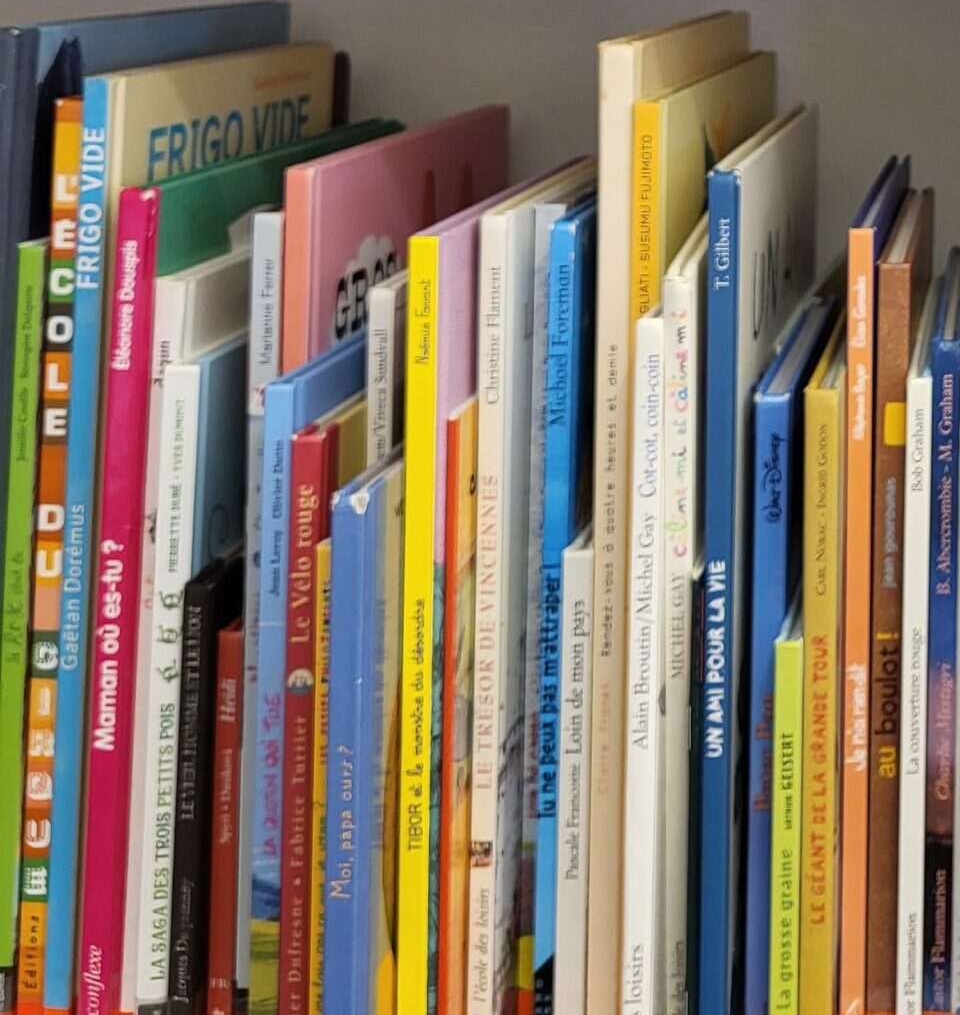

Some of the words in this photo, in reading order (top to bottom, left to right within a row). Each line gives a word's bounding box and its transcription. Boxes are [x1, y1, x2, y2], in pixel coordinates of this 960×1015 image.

[82, 127, 105, 191] VIDE
[77, 202, 102, 289] FRIGO
[714, 217, 731, 271] Gilbert
[715, 274, 730, 290] T.
[63, 503, 85, 593] Dorémus
[102, 539, 124, 554] ?
[101, 560, 124, 619] es-tu
[709, 559, 726, 594] VIE
[571, 600, 591, 638] pays
[709, 596, 726, 622] LA
[61, 598, 82, 671] Gaëtan
[97, 624, 121, 654] où
[875, 632, 898, 641] !
[570, 643, 585, 683] mon
[708, 629, 726, 684] POUR
[811, 633, 829, 683] TOUR
[93, 660, 119, 751] Maman
[566, 688, 584, 709] de
[707, 688, 726, 724] AMI
[875, 646, 899, 736] boulot
[159, 703, 176, 740] POIS
[565, 715, 583, 755] Loin
[811, 691, 829, 765] GRANDE
[706, 727, 725, 758] UN
[157, 745, 174, 807] PETITS
[878, 747, 896, 779] au
[811, 771, 827, 797] LA
[811, 802, 827, 825] DE
[154, 812, 171, 863] TROIS
[807, 830, 827, 896] GÉANT
[153, 867, 169, 900] DES
[151, 905, 168, 952] SAGA
[810, 901, 826, 926] LE
[149, 958, 166, 980] LA
